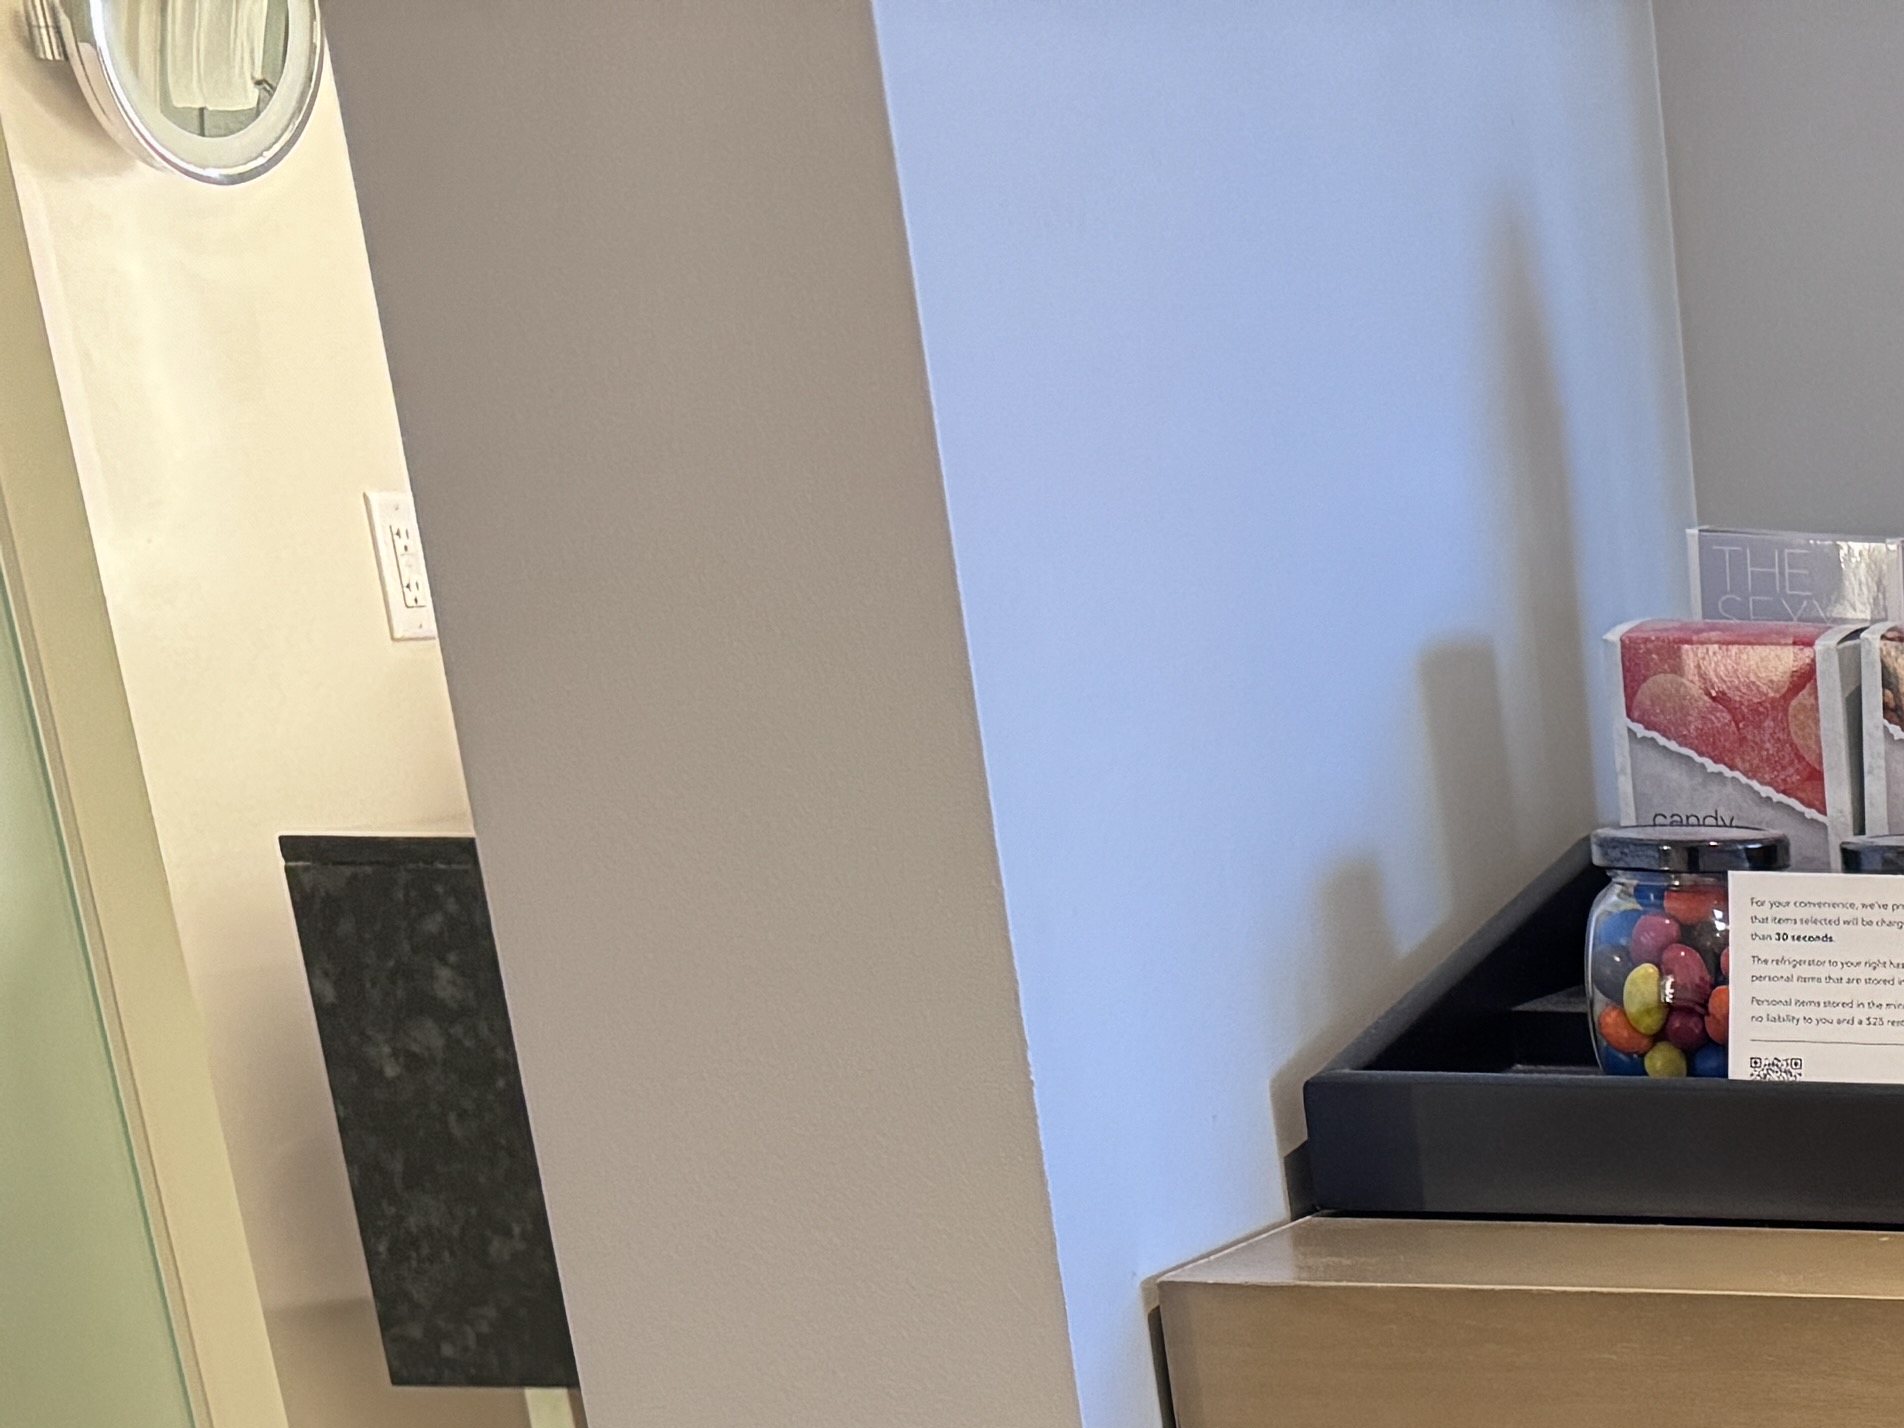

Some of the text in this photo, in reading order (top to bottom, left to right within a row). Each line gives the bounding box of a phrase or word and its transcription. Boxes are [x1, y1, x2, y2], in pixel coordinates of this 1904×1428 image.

[1712, 546, 1812, 595] THE
[1861, 917, 1873, 927] be
[1775, 932, 1788, 941] 30
[1828, 959, 1838, 968] to
